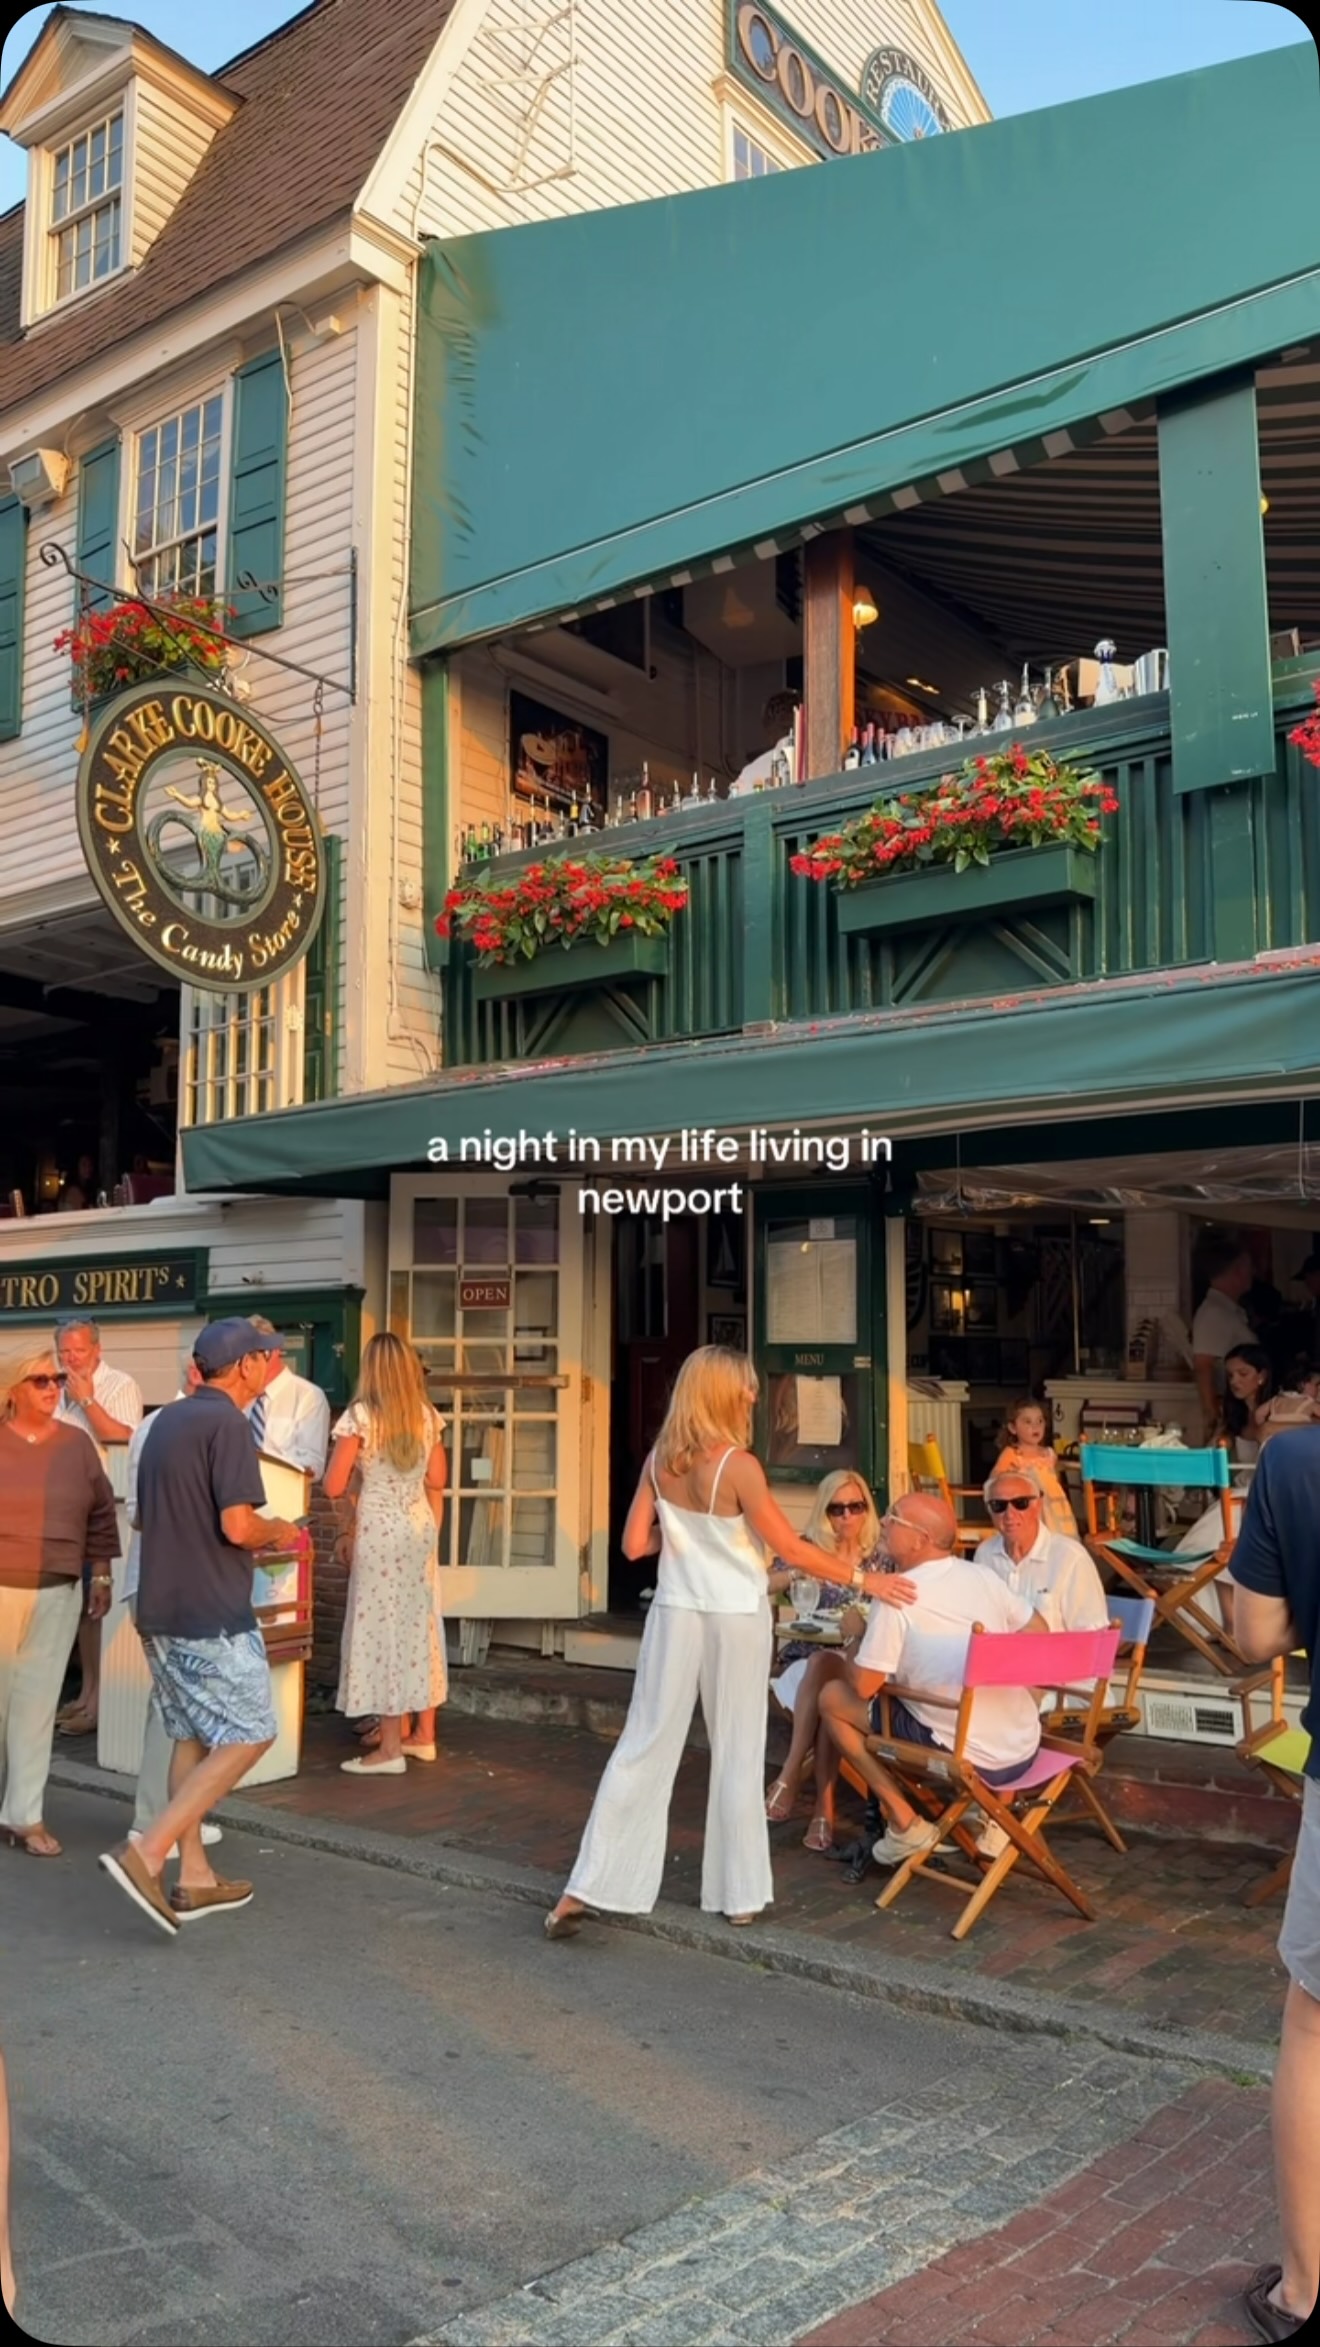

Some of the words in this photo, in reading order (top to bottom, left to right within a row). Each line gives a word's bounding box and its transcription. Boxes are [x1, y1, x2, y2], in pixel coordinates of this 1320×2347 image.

[738, 4, 880, 155] COOK
[95, 700, 176, 833] CLARKE
[171, 695, 273, 779] COOKE
[261, 769, 317, 894] HOUSE
[111, 859, 157, 928] The
[161, 922, 244, 980] Candy
[248, 910, 301, 968] Store
[0, 1274, 59, 1308] TRO
[463, 1287, 507, 1301] OPEN
[795, 1353, 824, 1366] MENU
